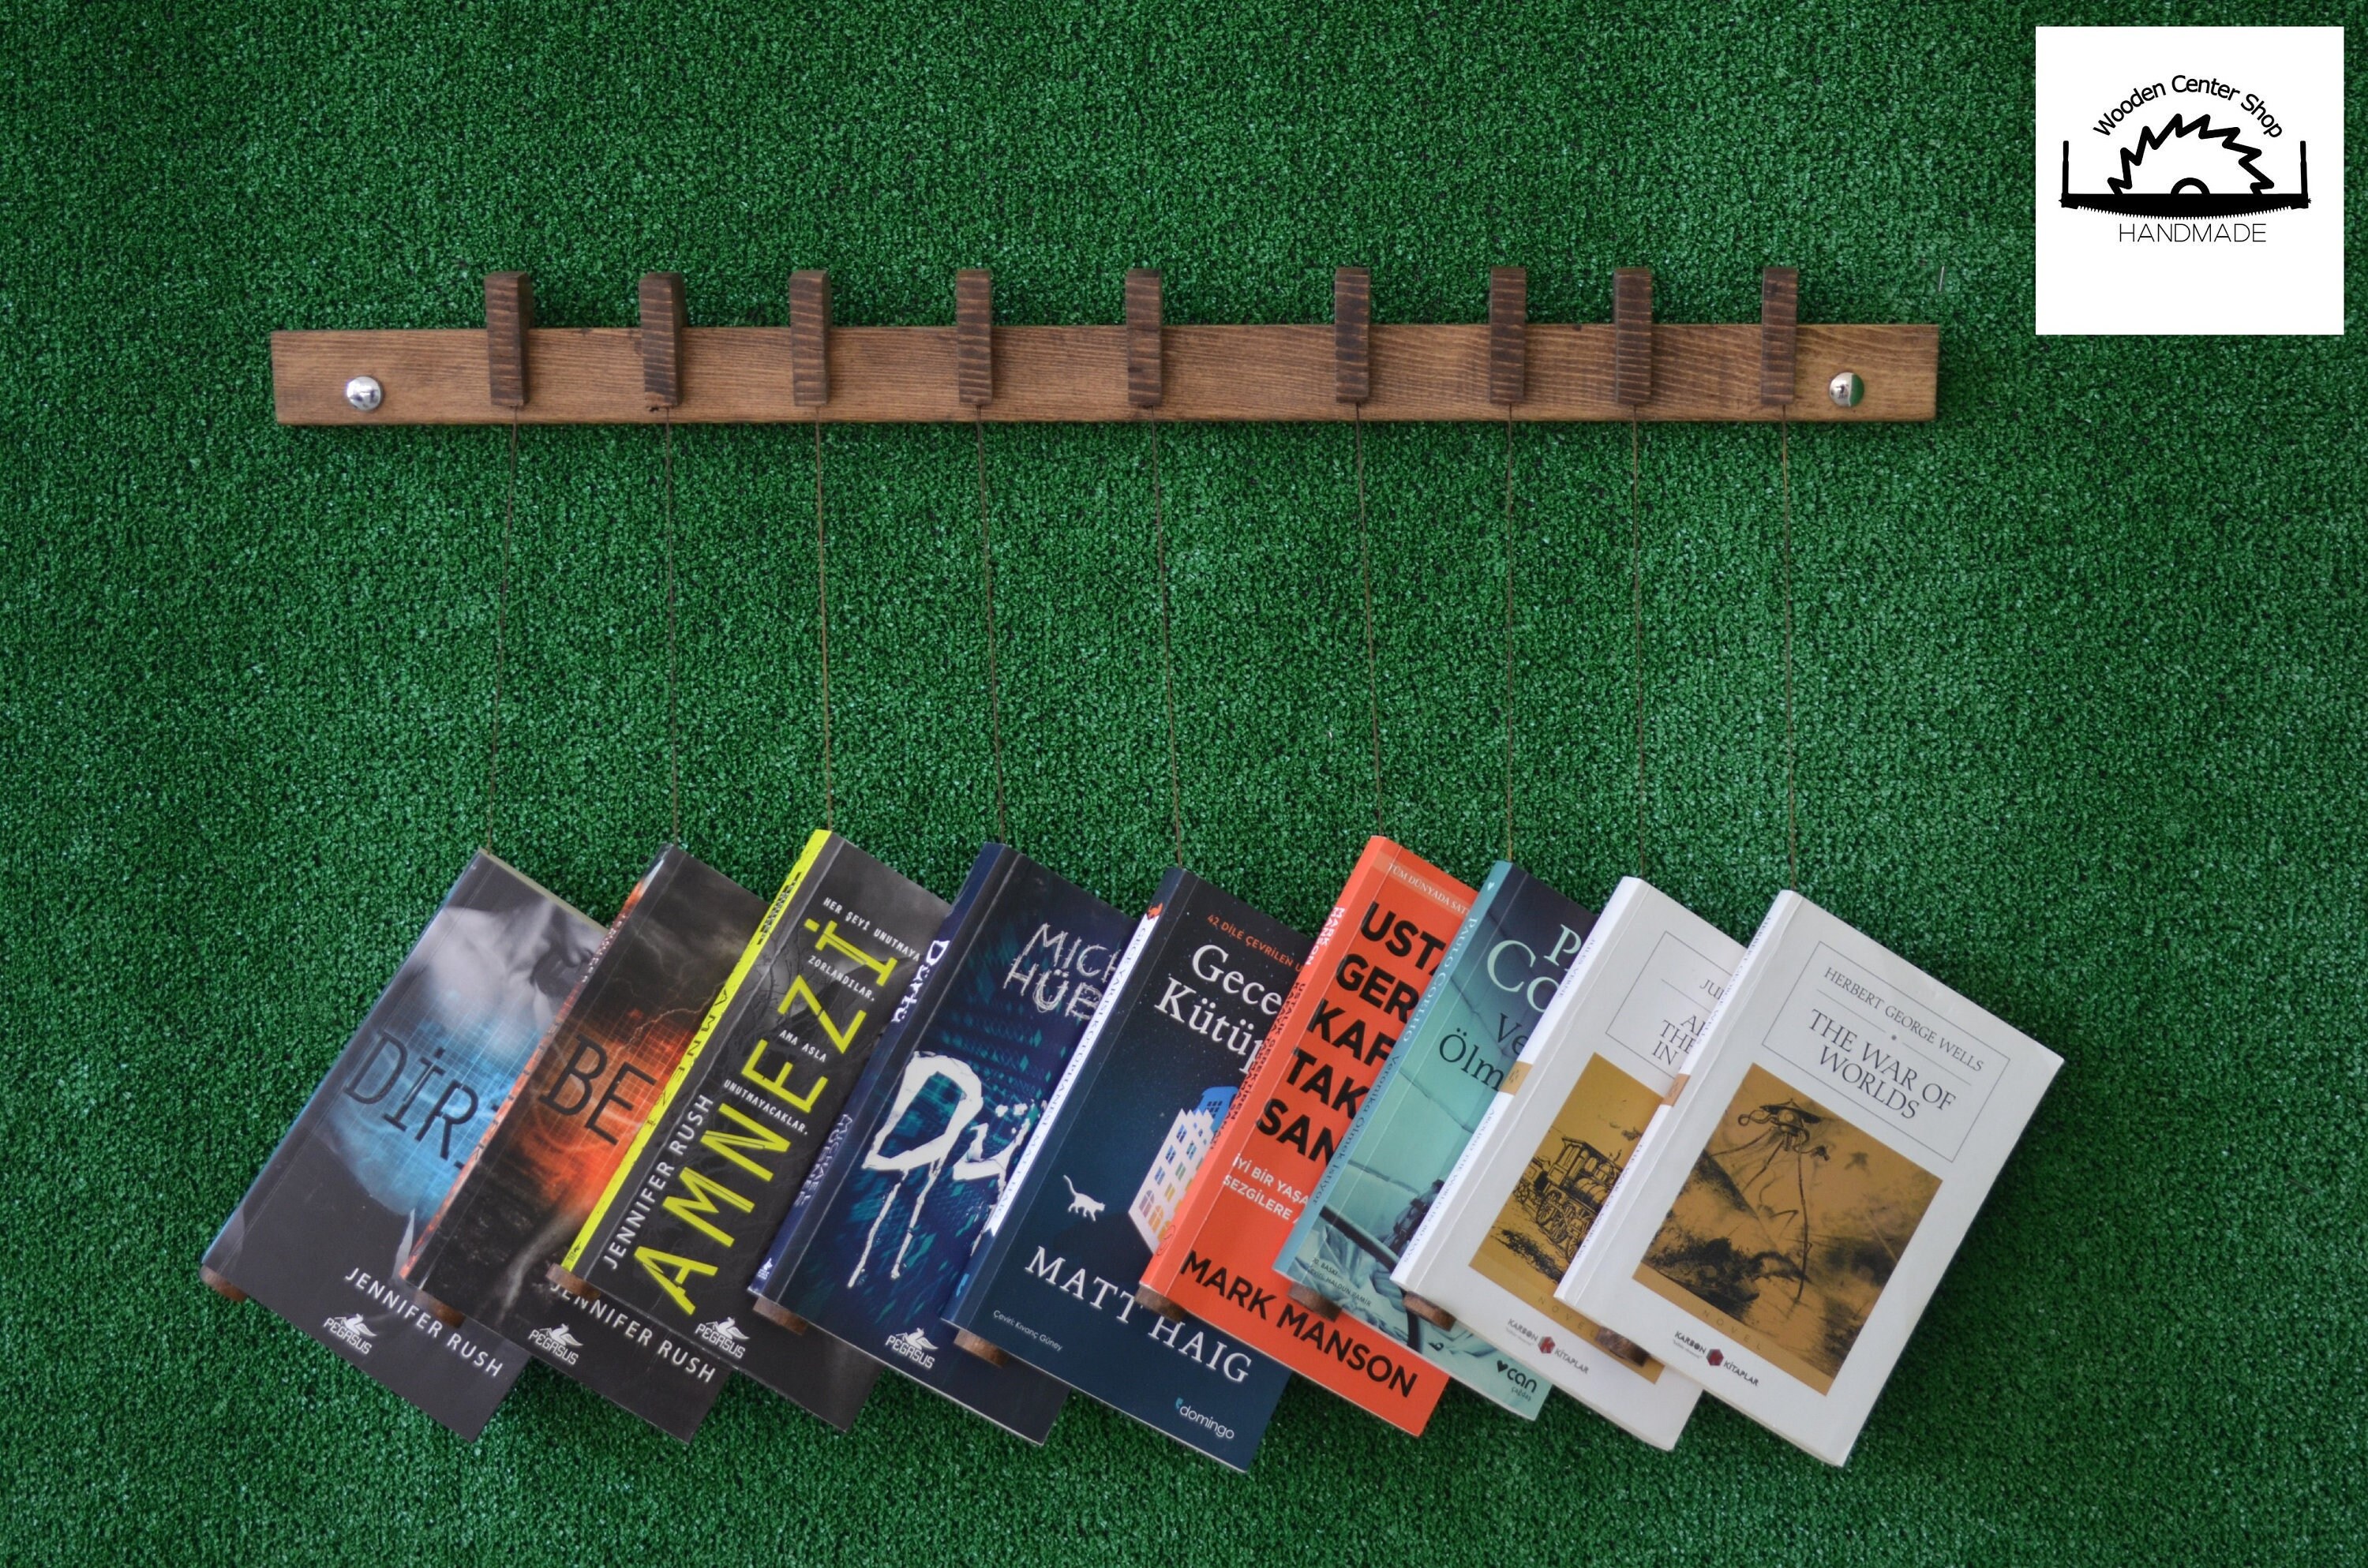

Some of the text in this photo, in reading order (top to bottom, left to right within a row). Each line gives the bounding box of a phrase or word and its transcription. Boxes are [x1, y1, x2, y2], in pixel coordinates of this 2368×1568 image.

[1388, 863, 1408, 881] TÜM
[1408, 873, 1449, 906] DÜNYADA
[823, 897, 921, 961] HER ŞEYİ UNUTMAYA
[1207, 914, 1220, 927] 42
[1221, 922, 1244, 940] DİLE
[1246, 936, 1294, 967] ÇEVRİLEN
[1304, 905, 1339, 967] MANSON
[1321, 906, 1345, 947] MARK
[1360, 901, 1447, 976] UST
[1442, 915, 1478, 970] PAULO
[1544, 923, 1581, 971] P
[807, 955, 875, 1001] ZORLANDILAR.
[891, 939, 950, 1024] Dürtü
[1192, 944, 1283, 1016] Gece
[1336, 953, 1420, 1024] GER
[1401, 970, 1447, 1043] COELHO
[1275, 982, 1306, 1035] USTALIK
[1307, 997, 1397, 1066] KAF
[1823, 967, 1984, 1072] HERBERT GEORGE WELLS
[779, 1029, 827, 1063] AMA ASLA
[1439, 1027, 1505, 1092] Ölm
[1651, 1041, 1679, 1065] IN
[1808, 1009, 1957, 1110] THE WAR OF
[343, 1028, 500, 1169] DİR
[538, 1034, 657, 1146] BE
[724, 1079, 809, 1136] UNUTMAYACAKLAR.
[1291, 1046, 1370, 1120] TAK
[1362, 1053, 1399, 1113] Veronika
[1819, 1044, 1920, 1119] WORLDS
[634, 918, 898, 1315] AMNEZİ
[603, 1094, 714, 1270] JENNIFER RUSH
[1223, 1174, 1293, 1221] SEZGİLERE
[1233, 1152, 1309, 1207] İYİ BİR YAŞA
[323, 1317, 373, 1355] PEGASUS
[345, 1267, 503, 1377] JENNIFER RUSH
[550, 1284, 716, 1383] JENNIFER RUSH
[695, 1323, 746, 1360] PEGASUS
[1025, 1245, 1252, 1383] MATT HAIG
[1040, 1334, 1063, 1353] Güney
[1180, 1249, 1418, 1398] MARK MANSON
[528, 1329, 579, 1366] PEGASUS
[885, 1334, 935, 1369] PEGASUS
[1555, 1347, 1590, 1374] KİTAPLAR
[1674, 1330, 1707, 1354] KARBON
[1724, 1360, 1759, 1387] KİTAPLAR
[1508, 1367, 1538, 1393] can
[1175, 1398, 1235, 1440] domingo
